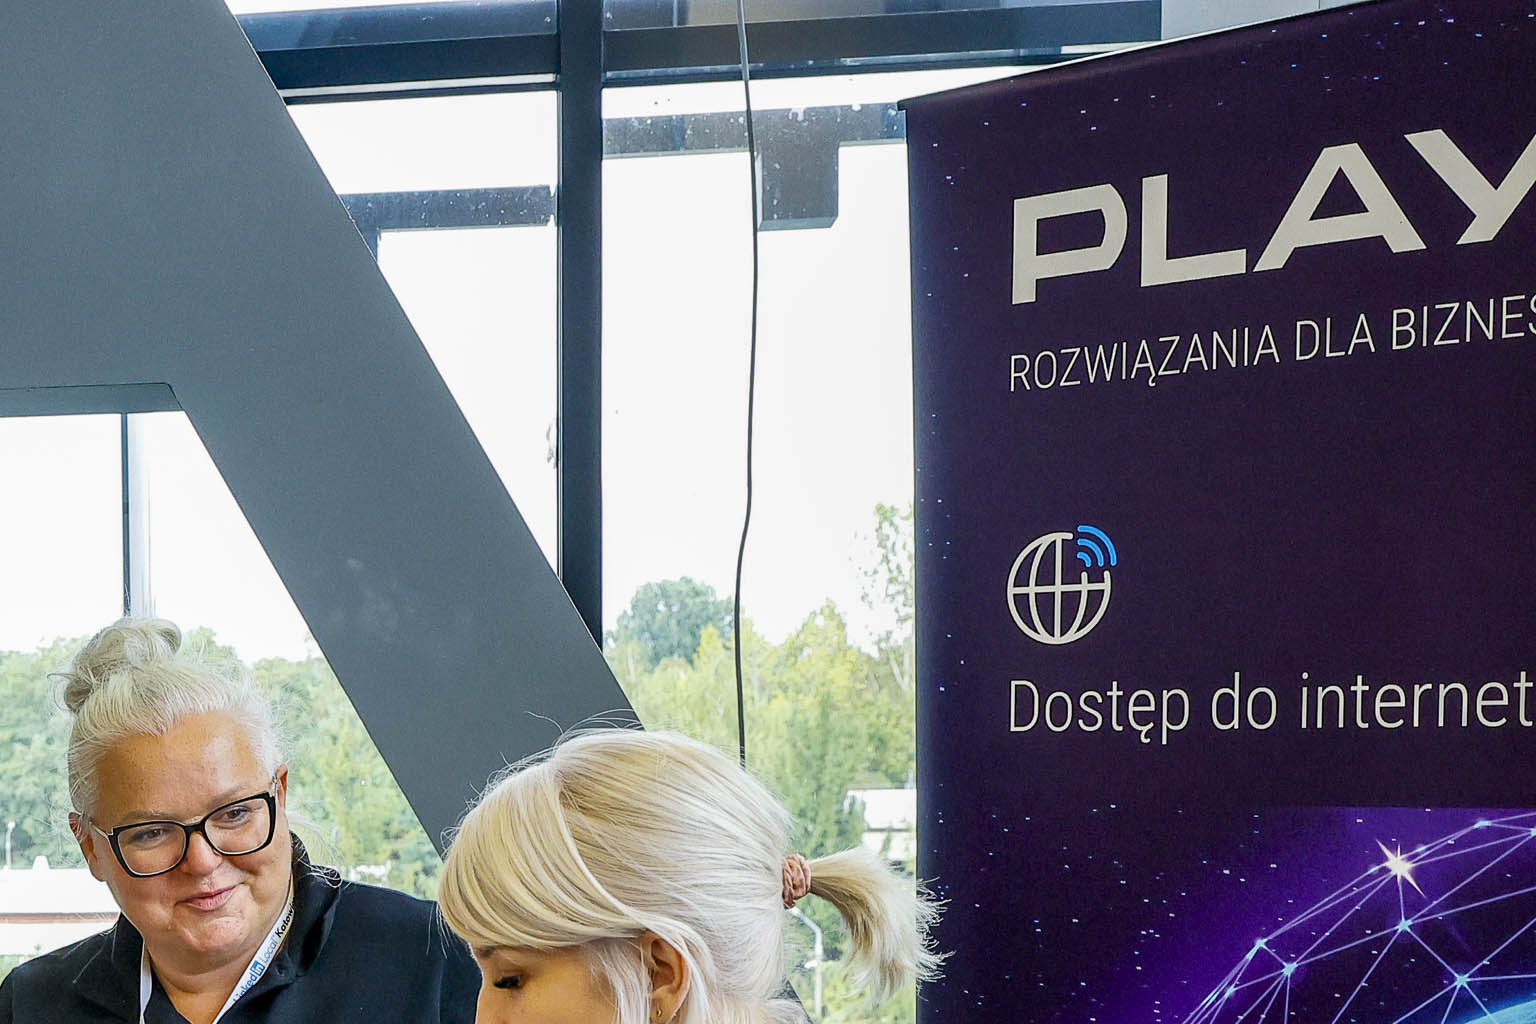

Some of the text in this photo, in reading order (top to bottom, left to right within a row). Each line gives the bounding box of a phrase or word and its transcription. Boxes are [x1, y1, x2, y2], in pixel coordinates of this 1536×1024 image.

[1011, 128, 1536, 306] PLAY
[1009, 324, 1281, 393] ROZWIĄZANIA
[1296, 312, 1376, 362] DLA
[1009, 670, 1533, 745] Dostęp do internet
